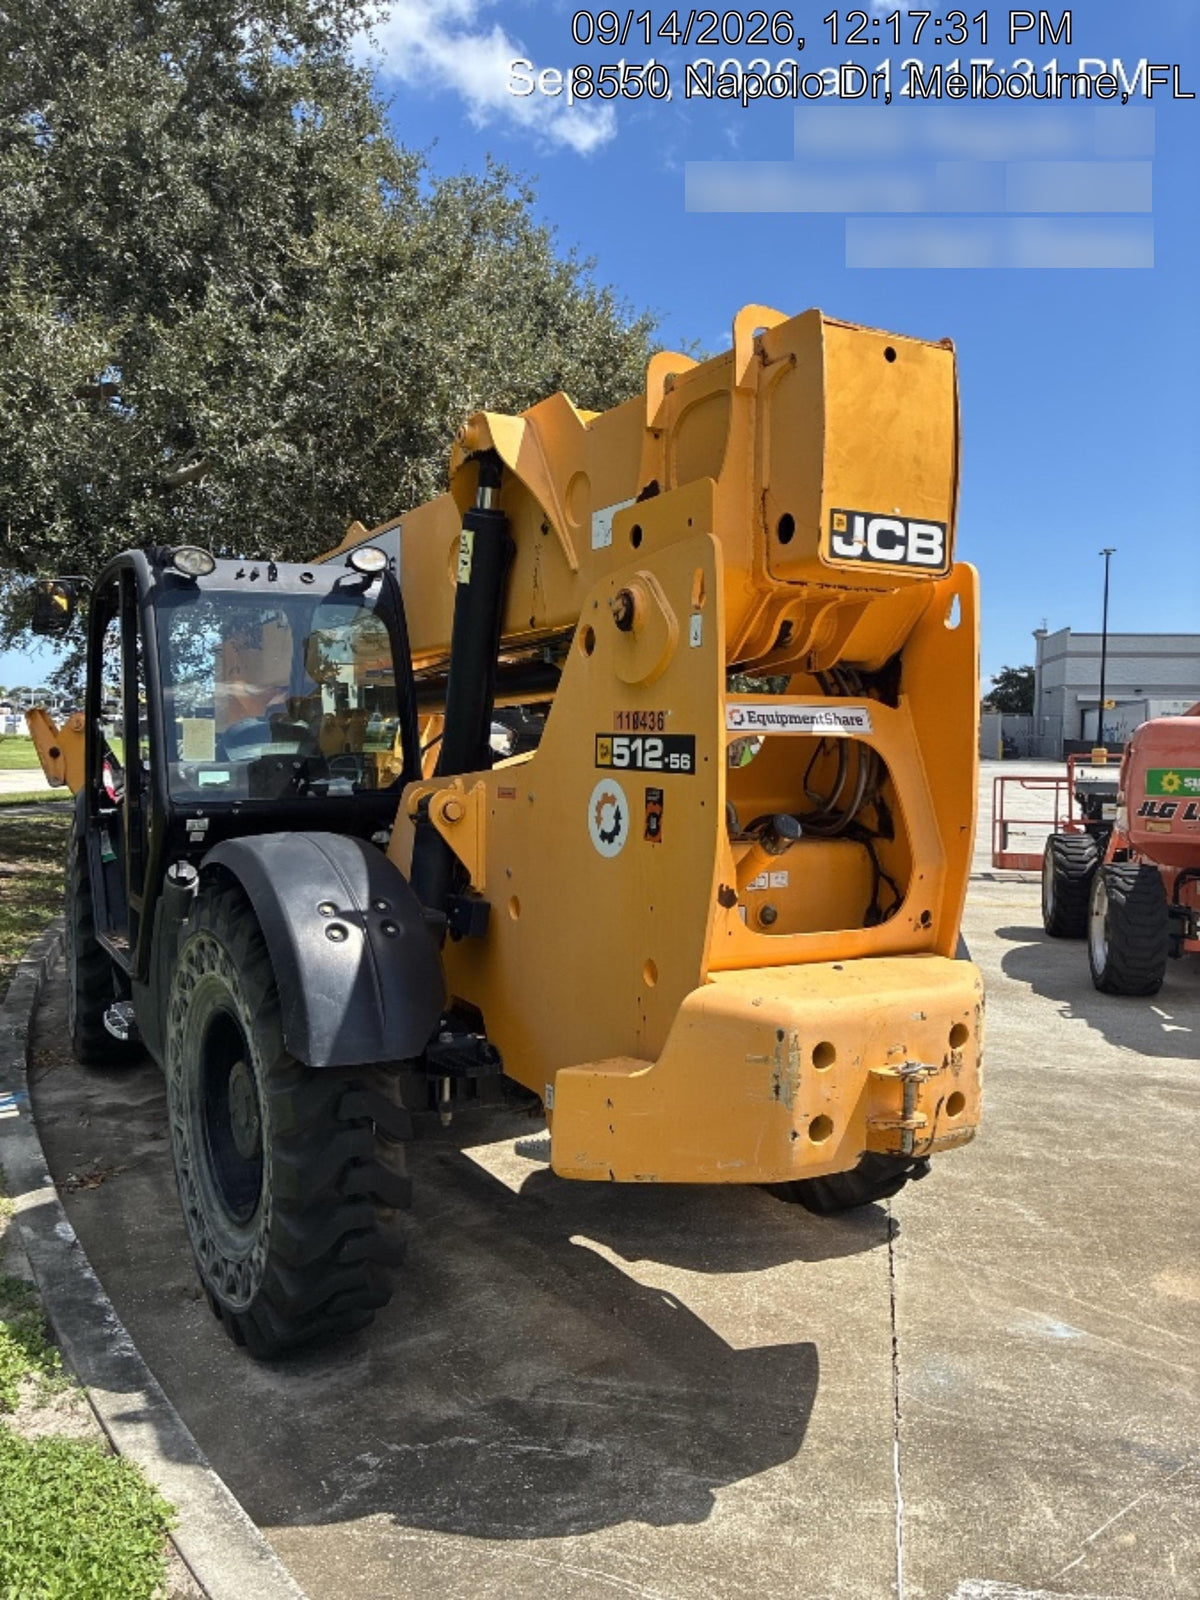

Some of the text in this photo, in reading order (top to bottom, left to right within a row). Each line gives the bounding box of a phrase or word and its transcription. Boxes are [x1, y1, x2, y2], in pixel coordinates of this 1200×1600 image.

[832, 515, 944, 564] JCB
[746, 710, 863, 727] EquipmentShare
[1137, 801, 1180, 819] JLG
